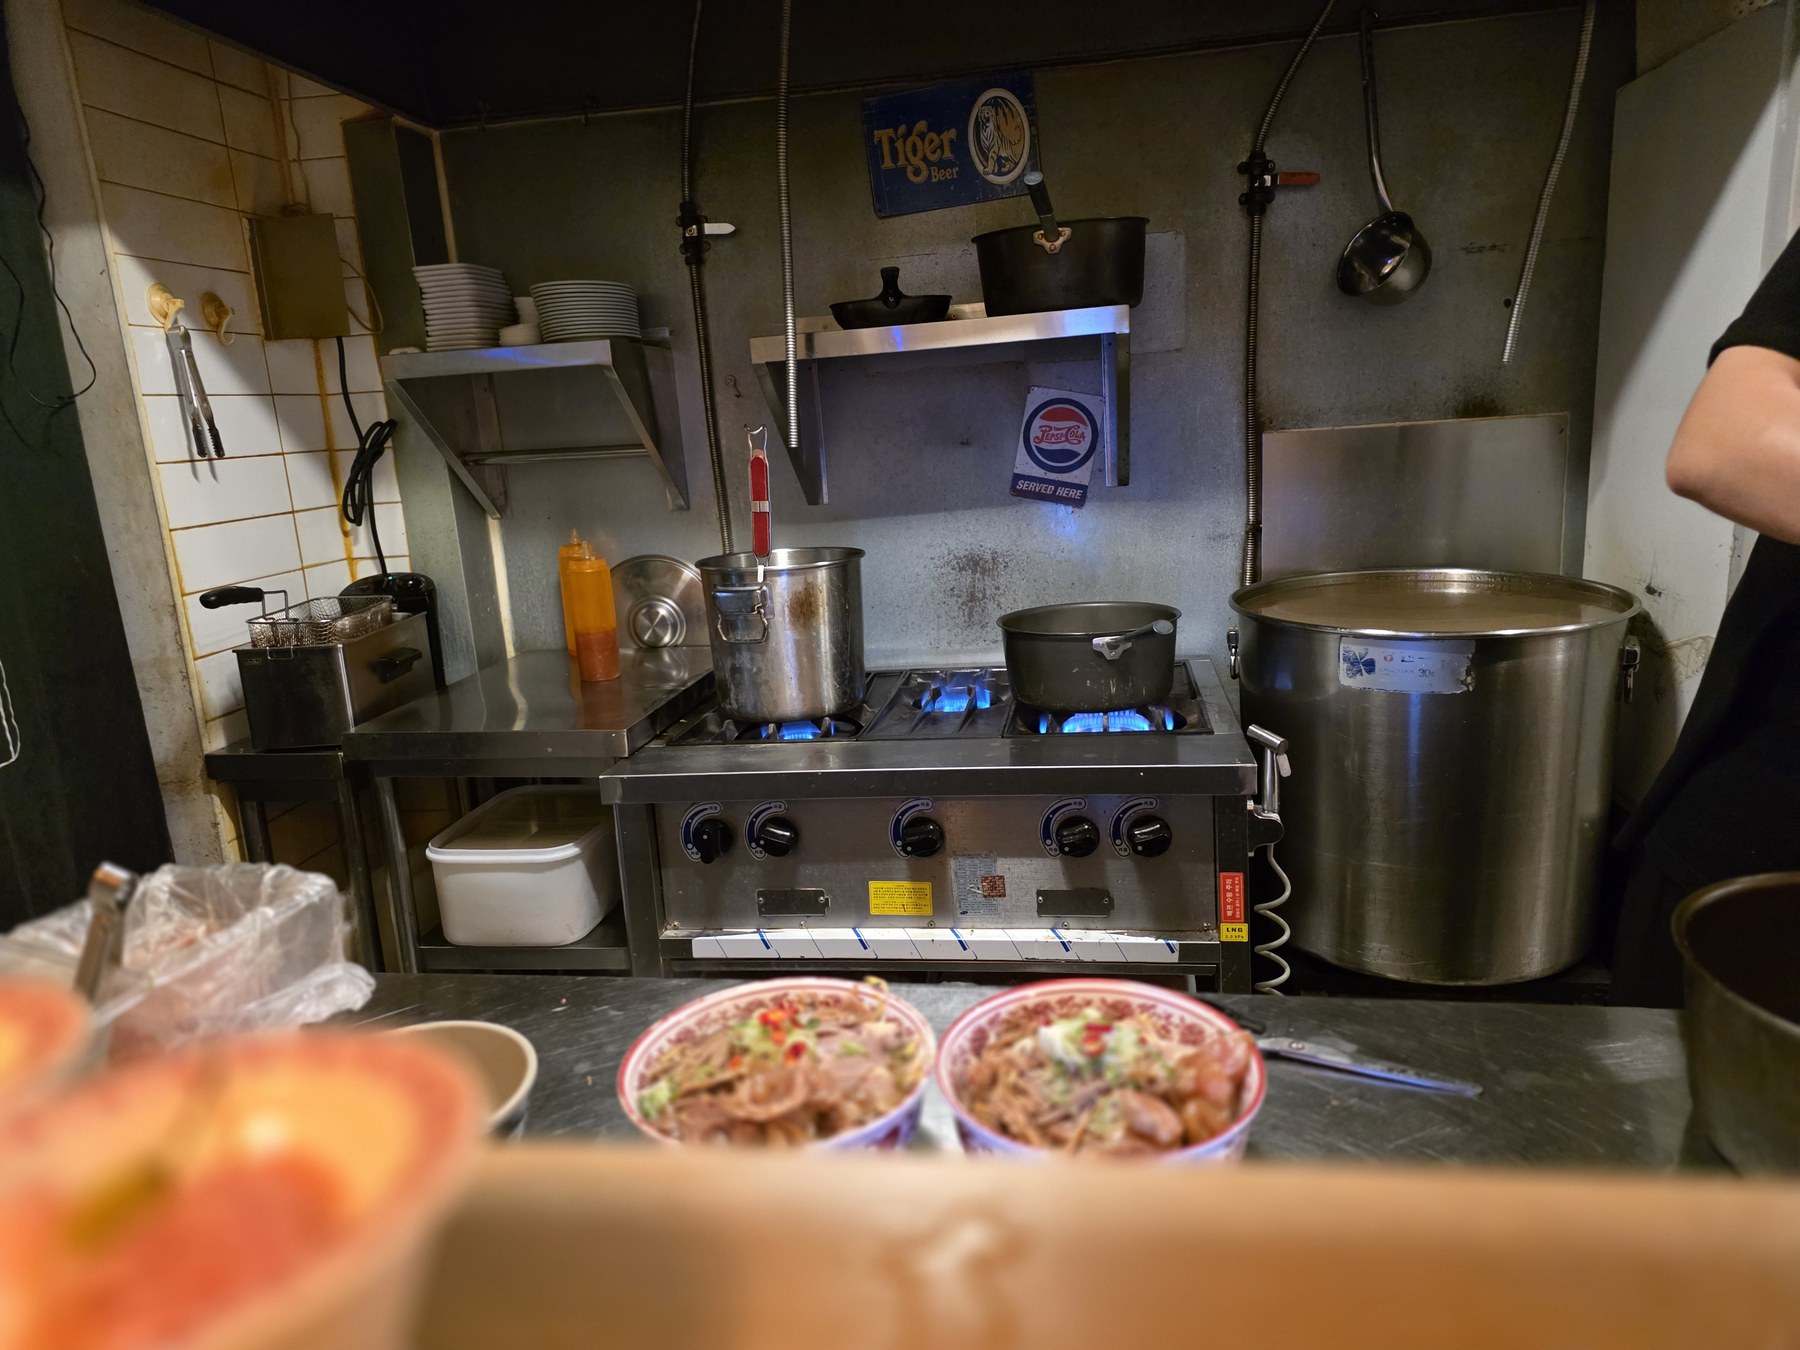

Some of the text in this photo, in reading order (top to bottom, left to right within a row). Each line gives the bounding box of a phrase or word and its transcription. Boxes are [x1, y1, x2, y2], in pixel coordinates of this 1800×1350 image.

[873, 119, 958, 185] Tiger
[930, 166, 959, 183] Beer
[1016, 479, 1084, 500] SERVED HERE
